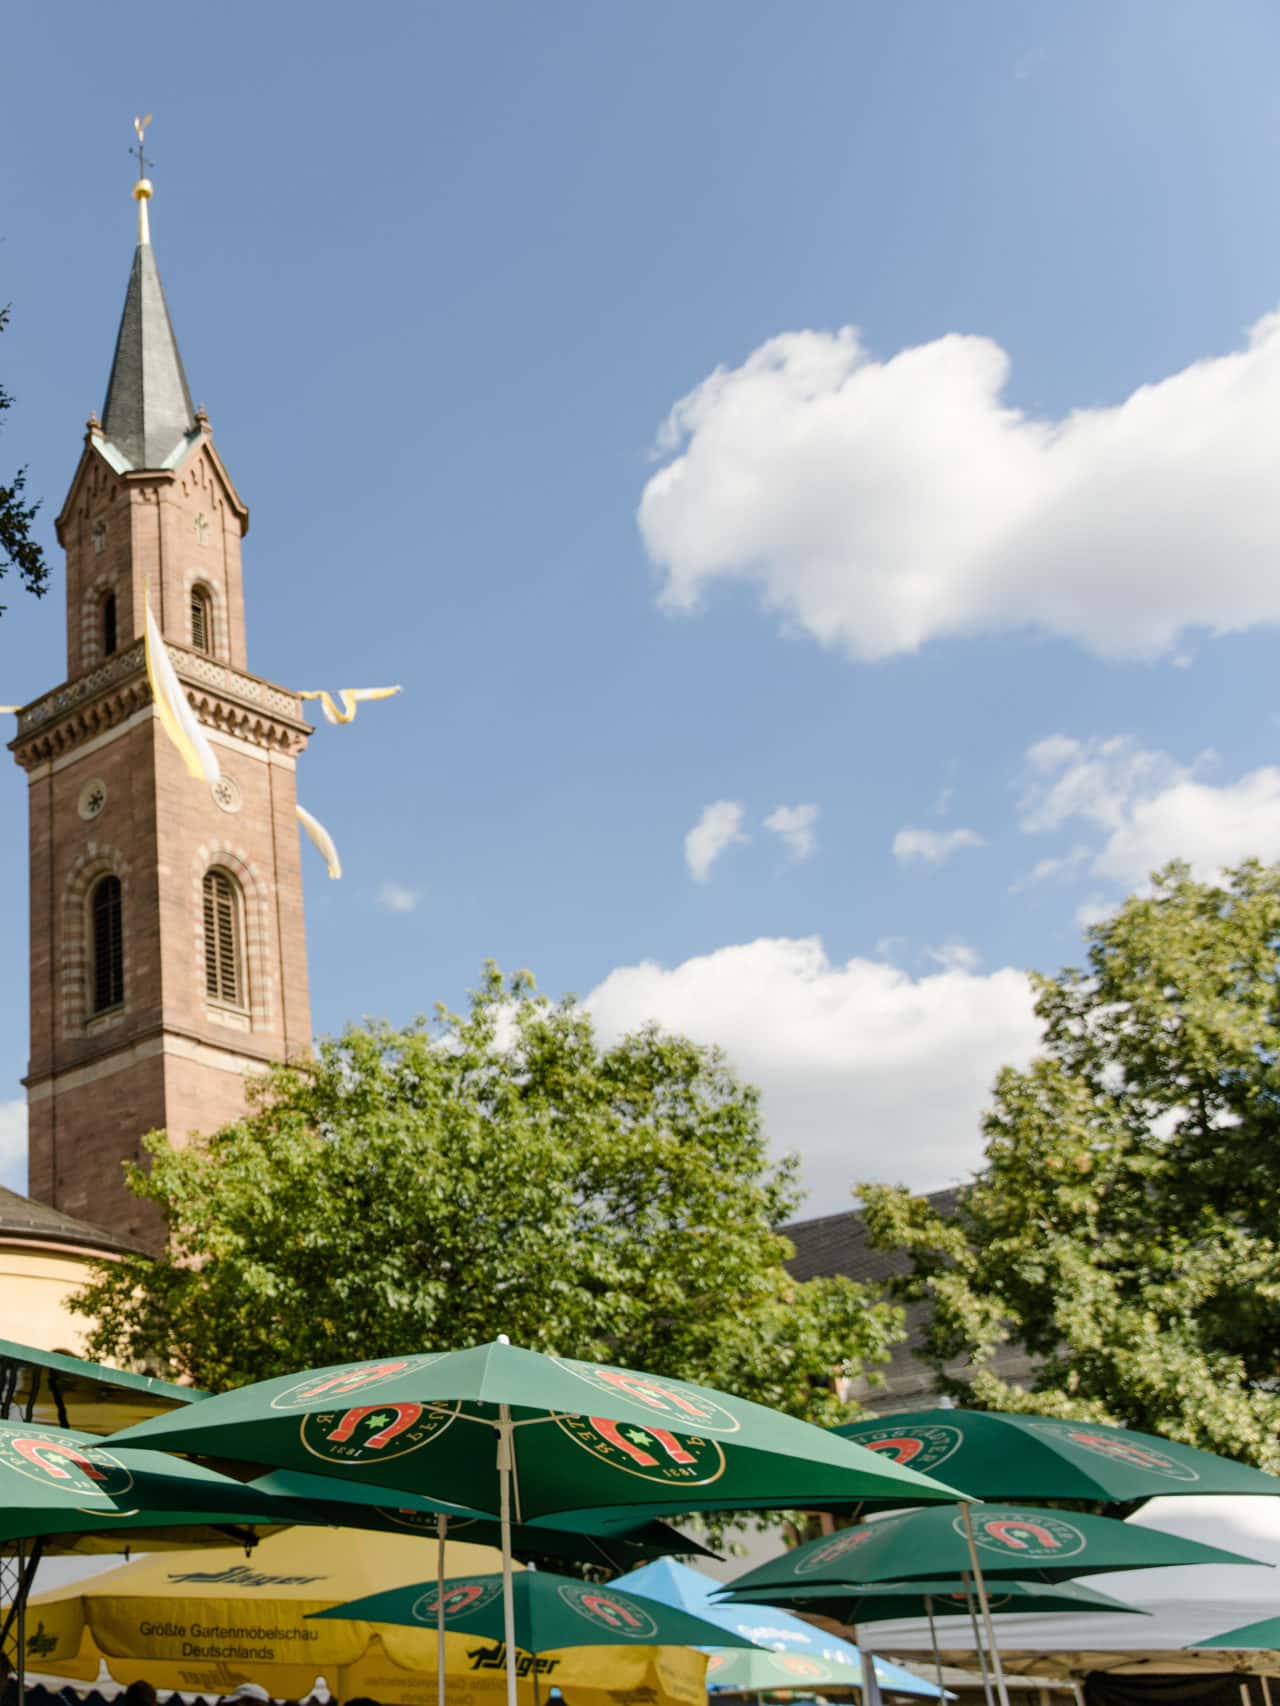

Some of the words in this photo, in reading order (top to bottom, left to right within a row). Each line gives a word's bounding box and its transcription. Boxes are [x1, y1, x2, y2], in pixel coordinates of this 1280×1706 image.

[139, 1621, 187, 1638] Größte
[190, 1622, 319, 1641] Gartenmöbelschau
[182, 1642, 275, 1660] Deutschlands
